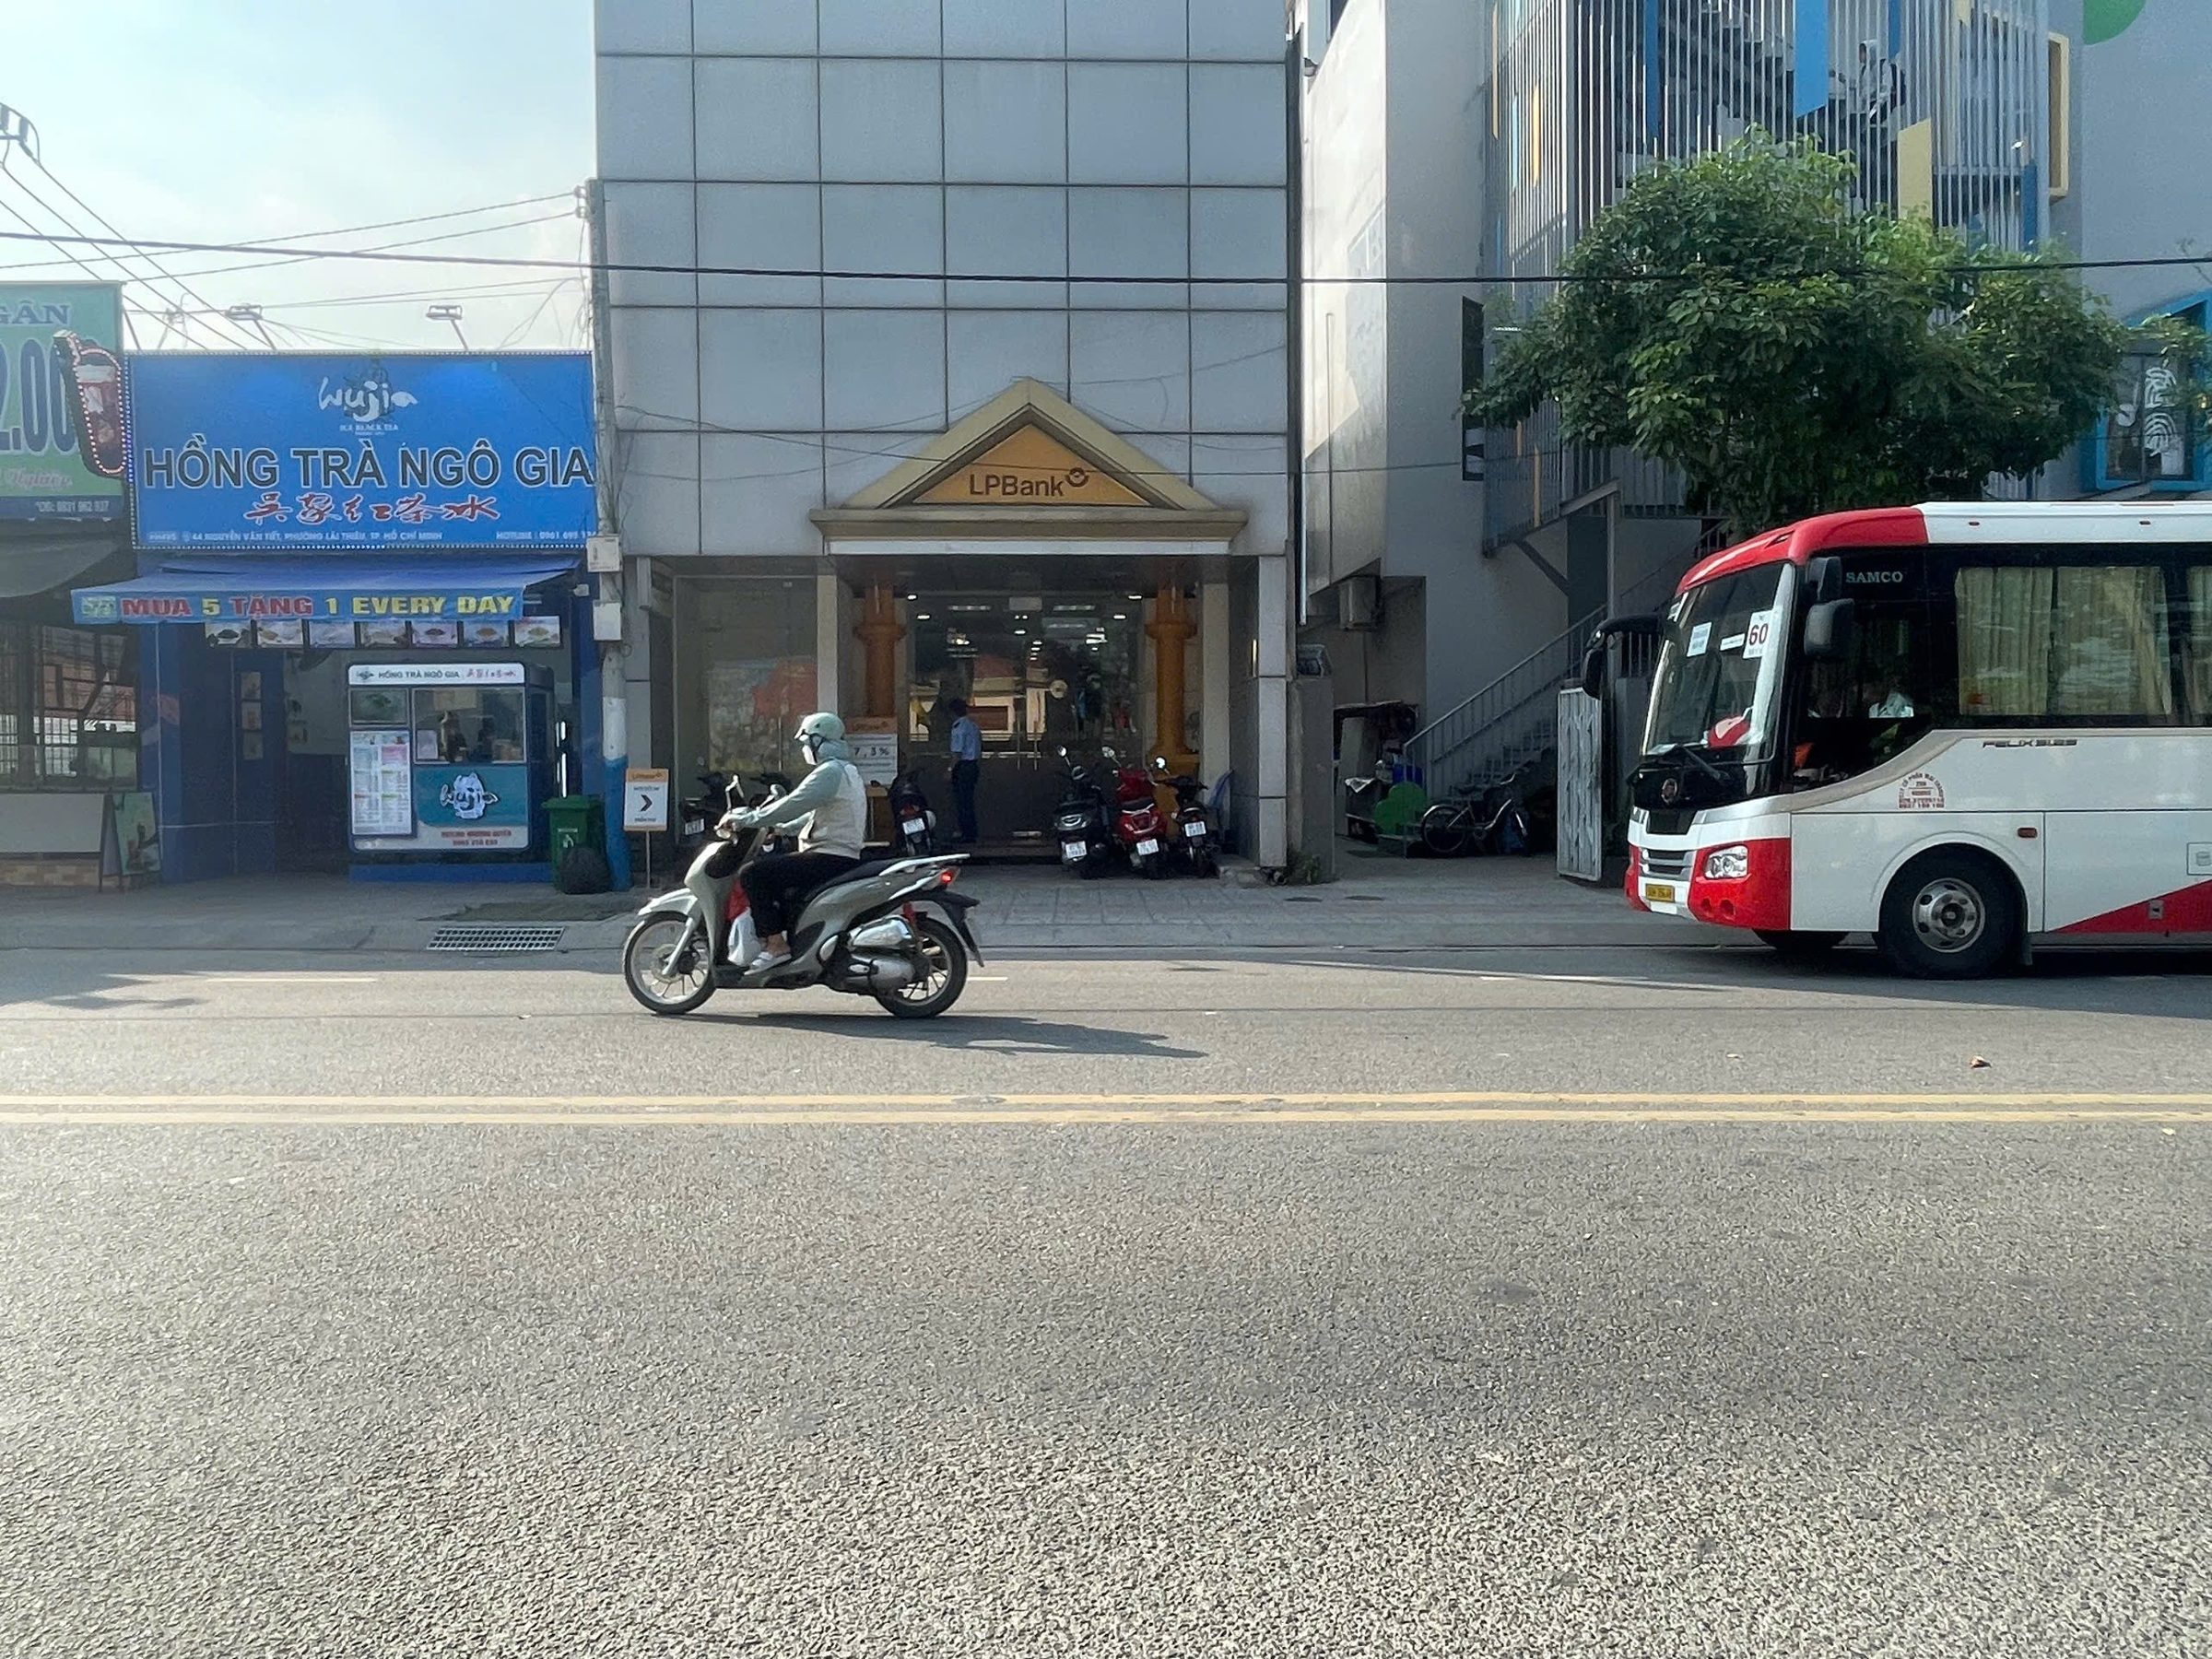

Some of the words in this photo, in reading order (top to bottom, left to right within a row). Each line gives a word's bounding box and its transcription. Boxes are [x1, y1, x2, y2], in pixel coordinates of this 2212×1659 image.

[145, 433, 279, 488] HỒNG
[290, 439, 387, 488] TRÀ
[399, 438, 500, 488] NGÔ
[514, 446, 595, 488] GIA
[970, 474, 1065, 496] LPBank
[1846, 571, 1903, 582] SAMCO
[121, 597, 193, 617] MUA
[201, 597, 220, 616] 5
[229, 593, 314, 620] TẶNG
[324, 596, 339, 615] 1
[352, 596, 446, 615] EVERY
[457, 595, 515, 615] DAY
[1748, 623, 1770, 645] 60
[406, 670, 422, 679] TRÀ
[445, 671, 461, 679] GIA
